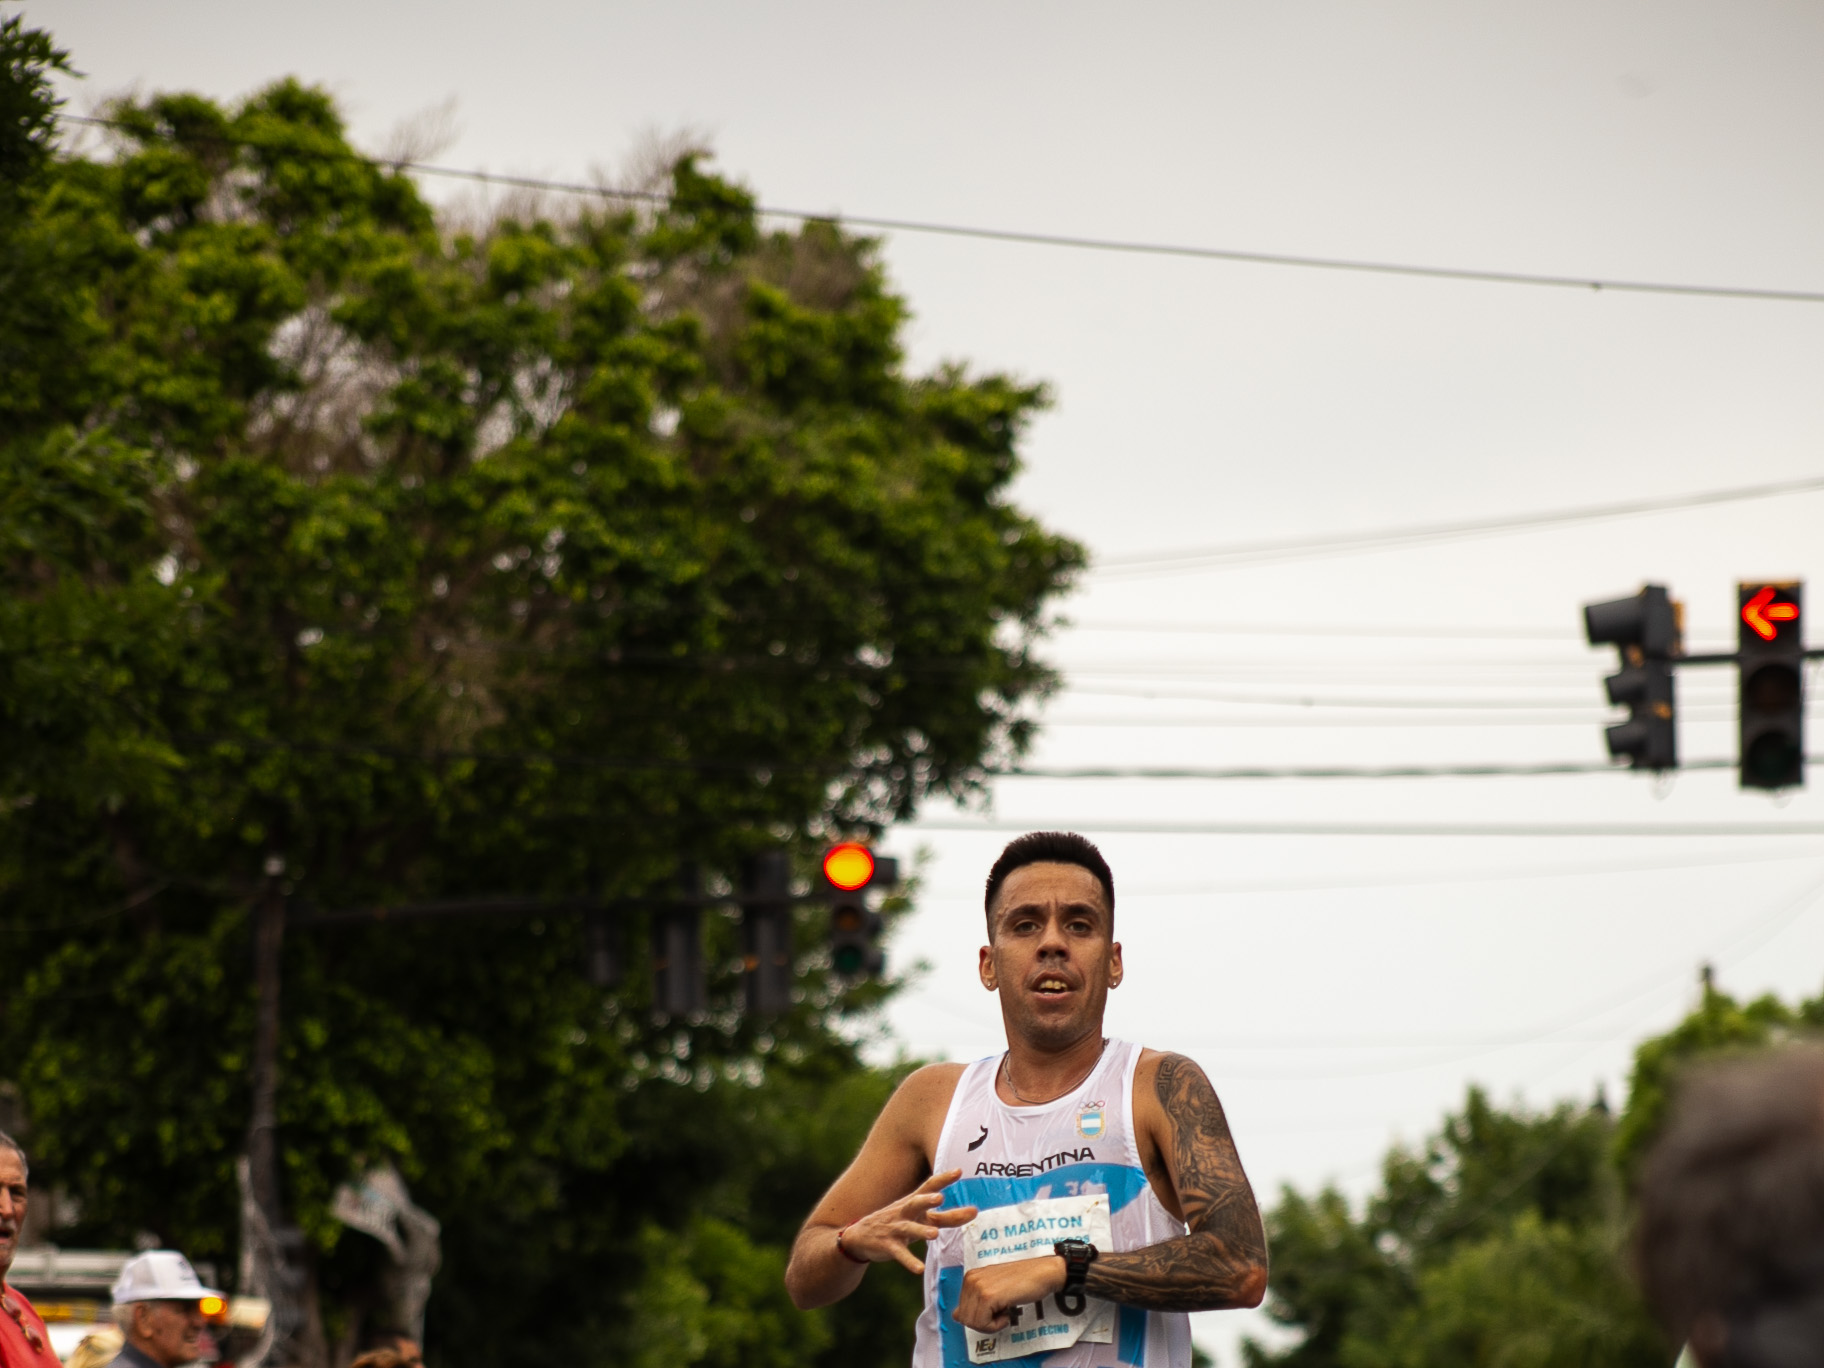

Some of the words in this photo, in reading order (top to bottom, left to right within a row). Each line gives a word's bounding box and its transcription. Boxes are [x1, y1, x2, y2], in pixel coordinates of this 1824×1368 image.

[974, 1147, 1096, 1178] ARGENTINA
[980, 1228, 999, 1241] 40
[1004, 1215, 1084, 1238] MARATON
[977, 1242, 1029, 1260] EMPALME
[1038, 1323, 1070, 1337] VECINO
